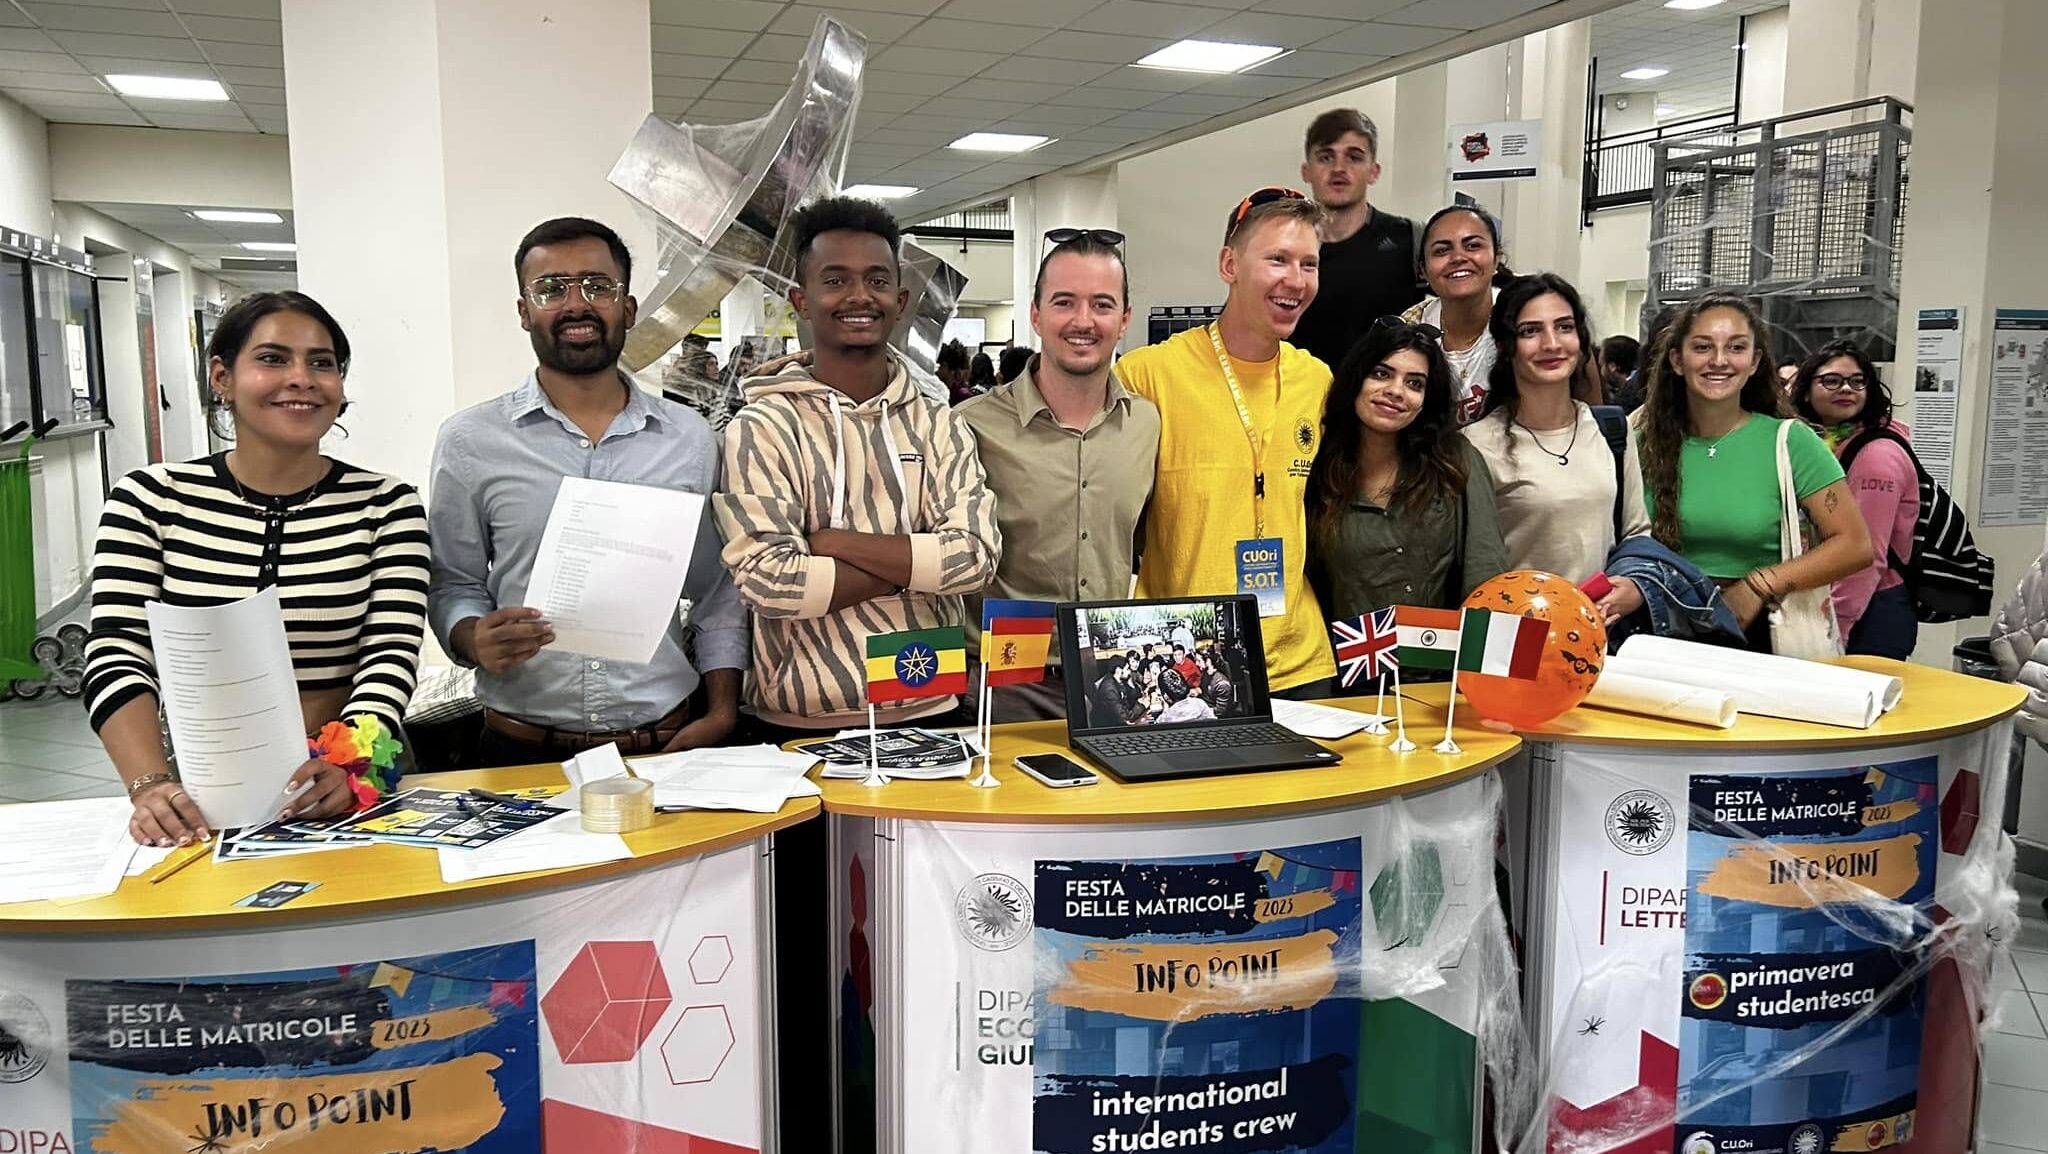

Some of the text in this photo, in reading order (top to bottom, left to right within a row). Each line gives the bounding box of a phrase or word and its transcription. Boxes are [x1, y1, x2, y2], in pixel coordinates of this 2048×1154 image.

[1861, 478, 1894, 492] LOVE
[1242, 549, 1277, 563] CUOri
[1243, 572, 1278, 589] S.O.T.
[1715, 790, 1764, 805] FESTA
[1714, 801, 1857, 822] DELLE MATRICOLE
[1768, 849, 1881, 885] INFO POINT
[1066, 880, 1125, 897] FESTA
[1066, 892, 1246, 918] DELLE MATRICOLE
[1262, 898, 1295, 917] 2023
[1132, 949, 1282, 993] INFO POINT
[1730, 962, 1855, 993] primavera
[106, 1003, 185, 1024] FESTA
[1737, 987, 1876, 1017] studentesca
[108, 1013, 358, 1048] DELLE MATRICOLE
[383, 1018, 431, 1042] 2023
[1093, 1067, 1288, 1116] international
[201, 1079, 417, 1138] INFO POINT
[1091, 1111, 1298, 1153] students crew
